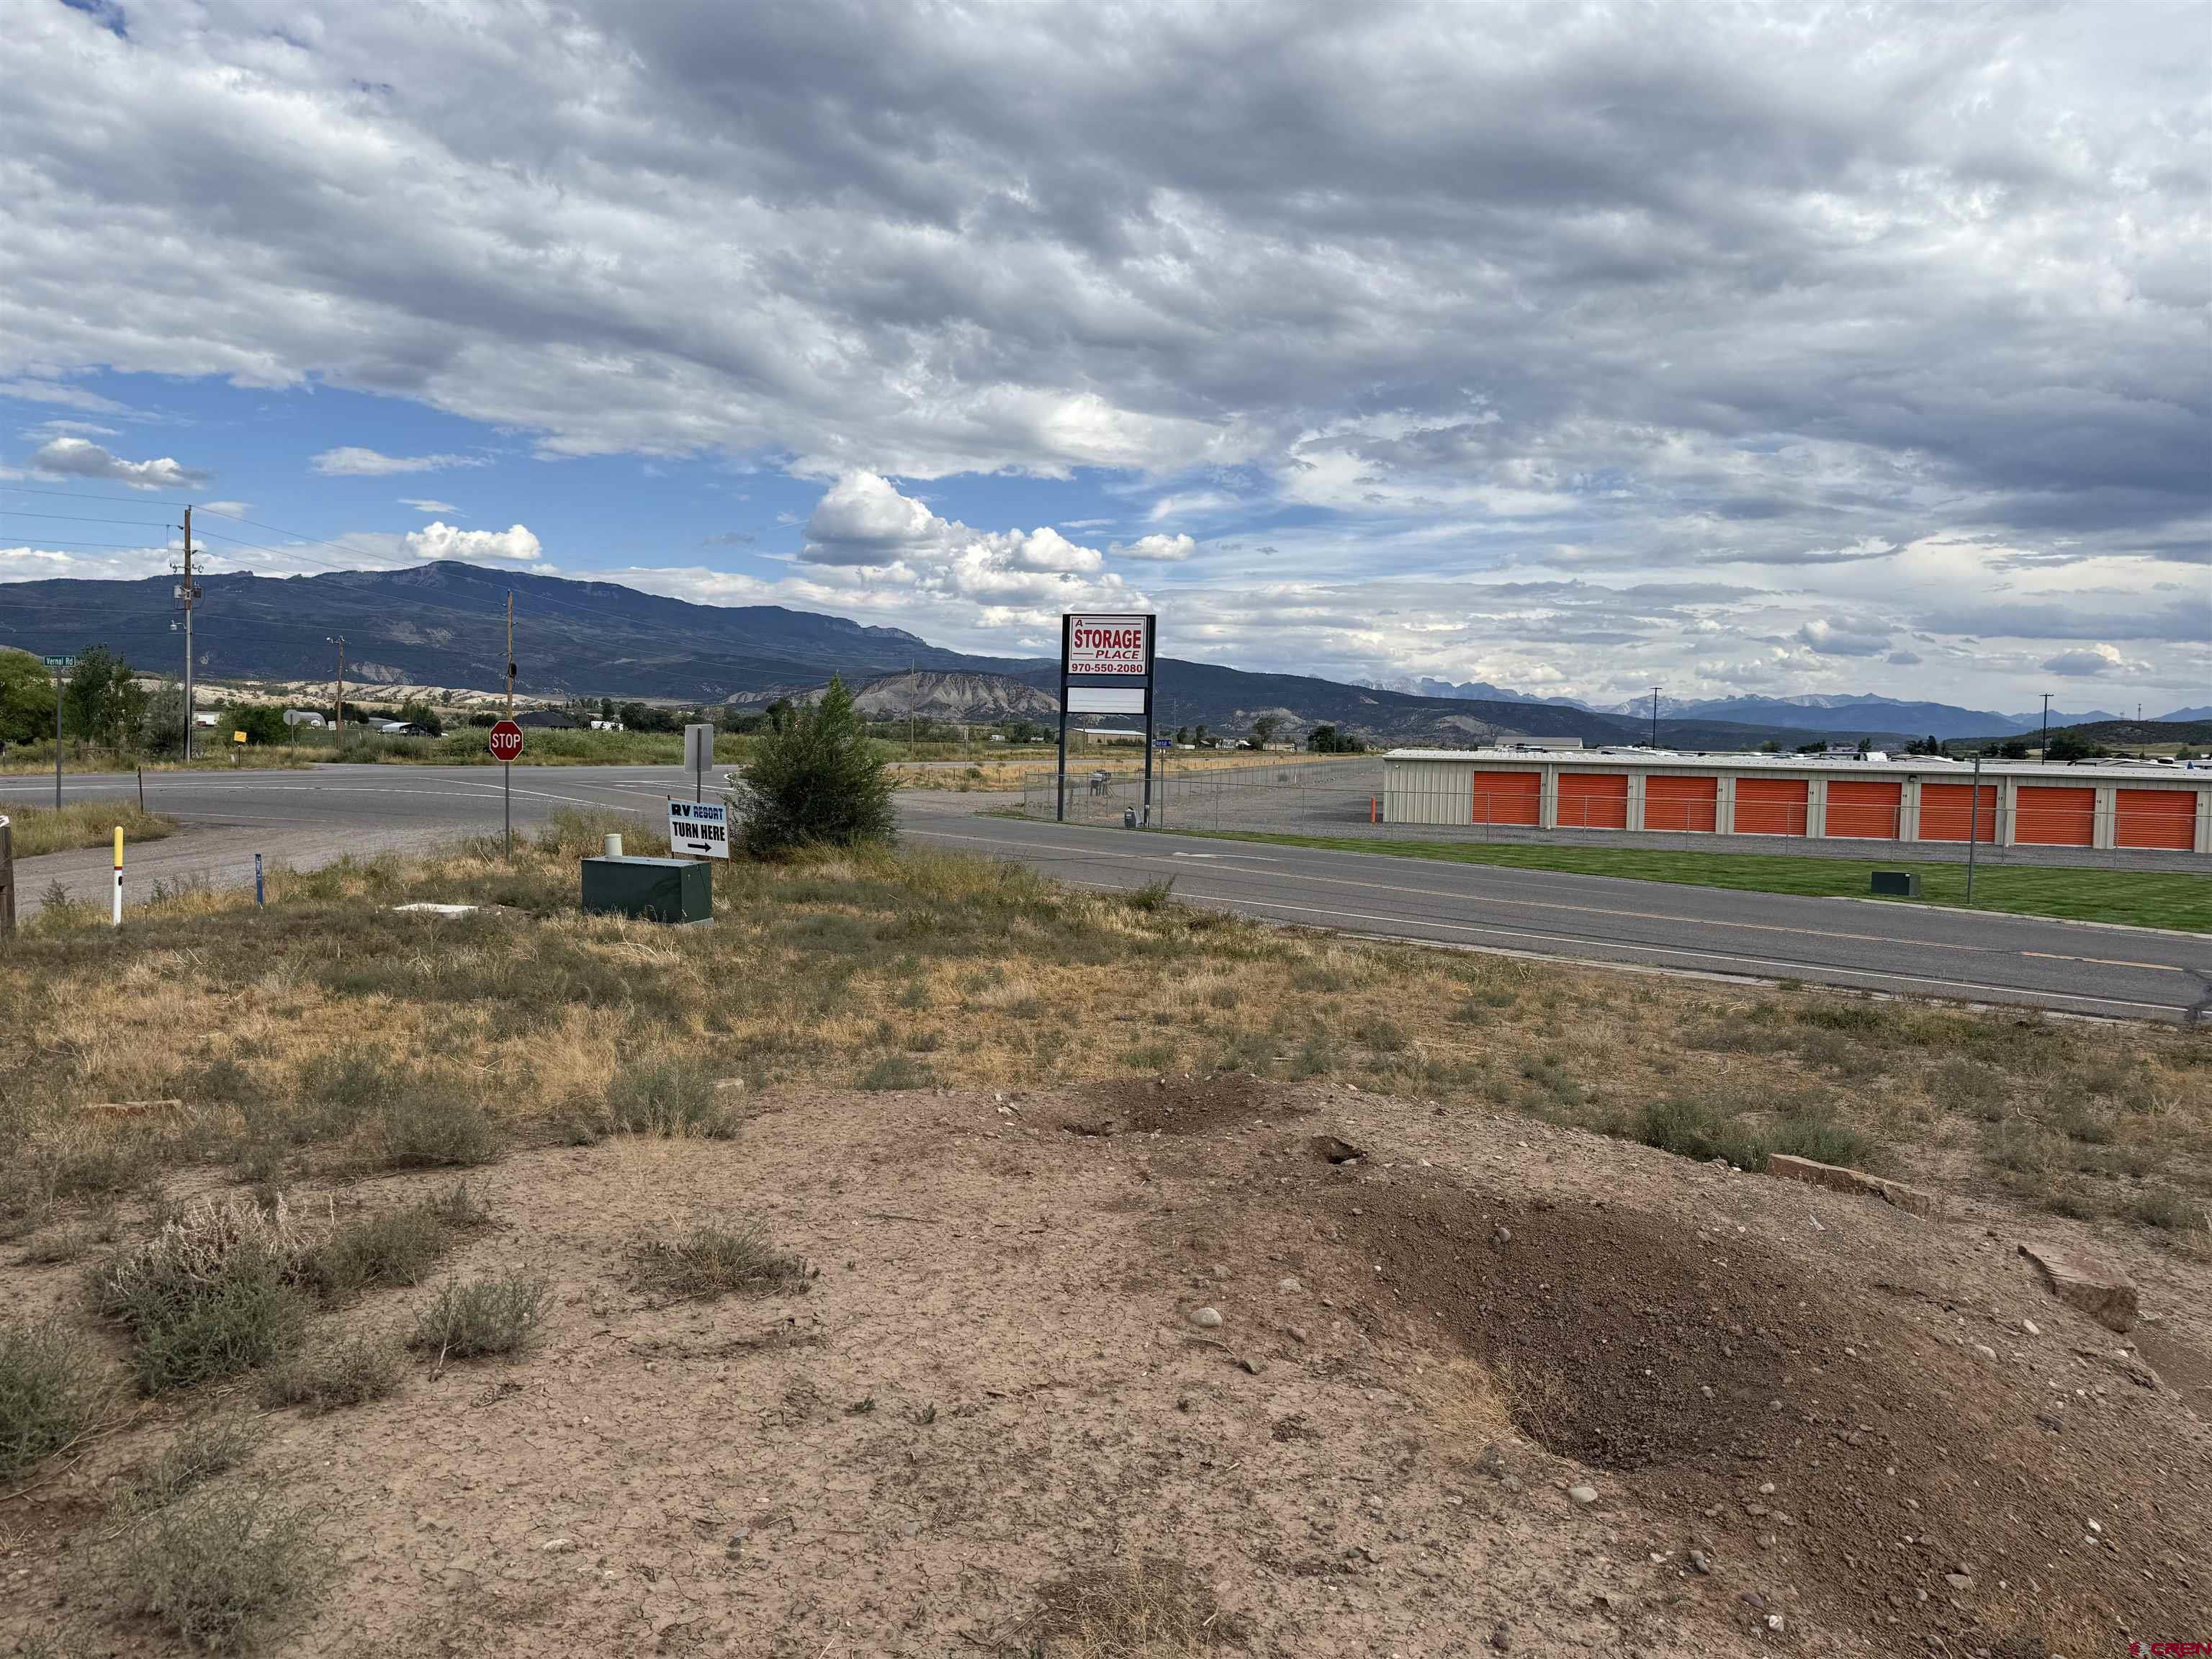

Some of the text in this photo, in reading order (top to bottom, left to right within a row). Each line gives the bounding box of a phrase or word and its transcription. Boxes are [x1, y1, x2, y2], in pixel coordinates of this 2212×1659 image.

[1074, 629, 1141, 649] STORAGE
[46, 657, 73, 665] Vernal Rd
[1095, 650, 1140, 660] PLACE
[1071, 663, 1143, 673] 970-550-2080
[492, 733, 521, 748] STOP
[671, 804, 724, 820] RV RESORT
[673, 822, 725, 841] TURN HERE
